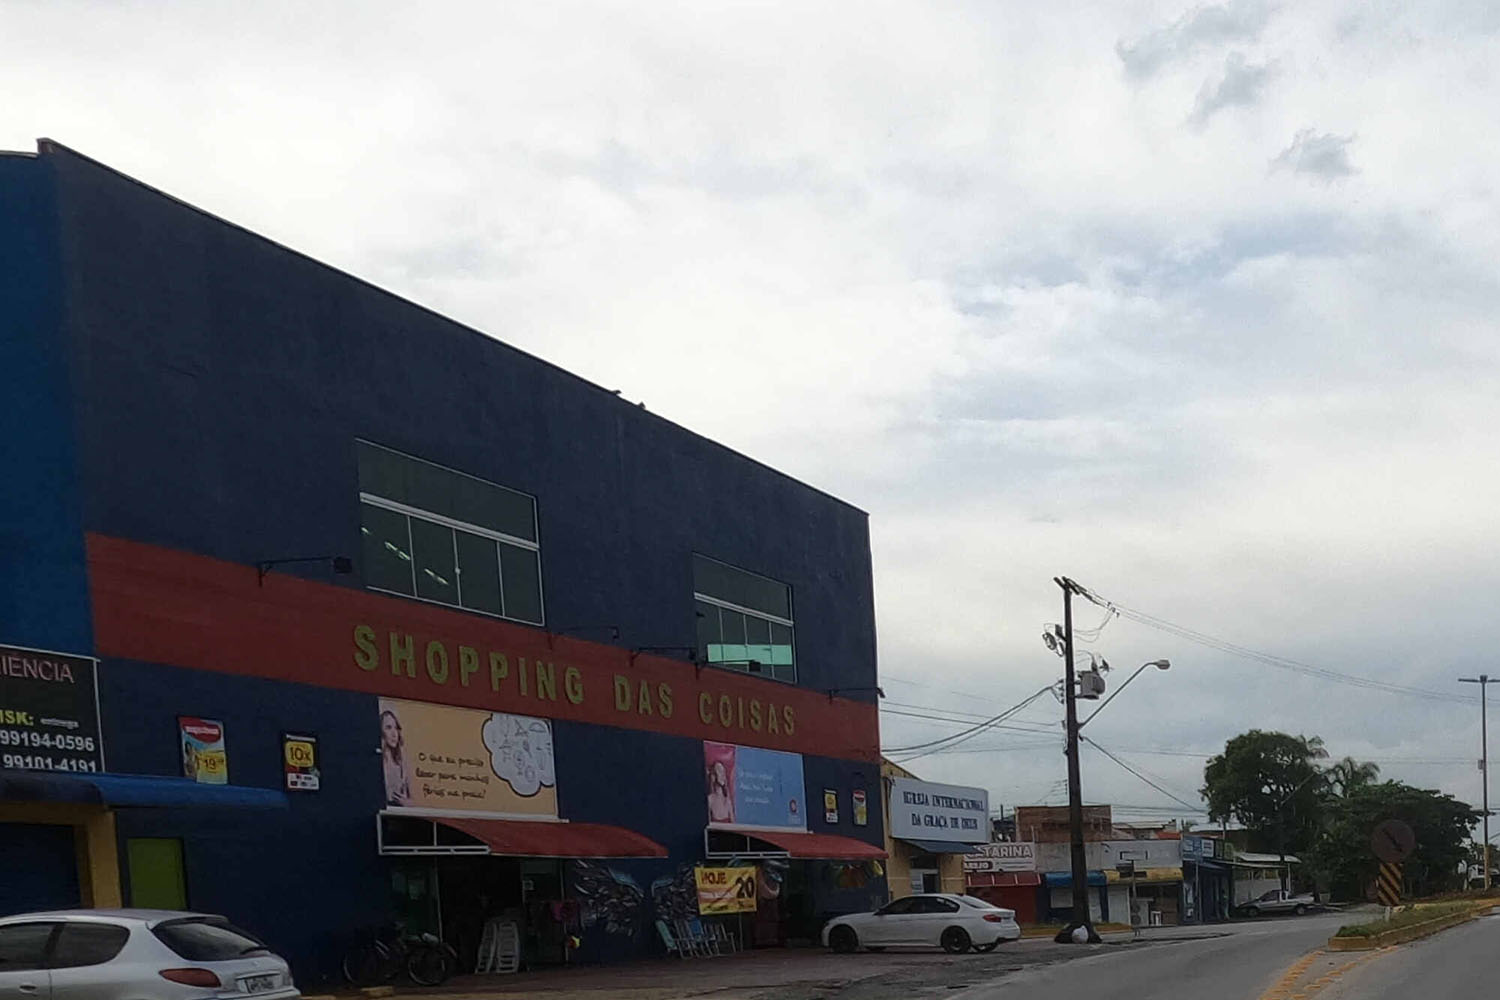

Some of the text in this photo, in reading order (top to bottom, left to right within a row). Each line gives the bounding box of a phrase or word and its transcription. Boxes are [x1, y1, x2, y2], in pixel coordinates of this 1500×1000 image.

[353, 624, 796, 737] SHOPPING DAS COISAS
[0, 729, 95, 752] 99194-0596
[911, 813, 921, 826] DA
[734, 876, 755, 899] 20
